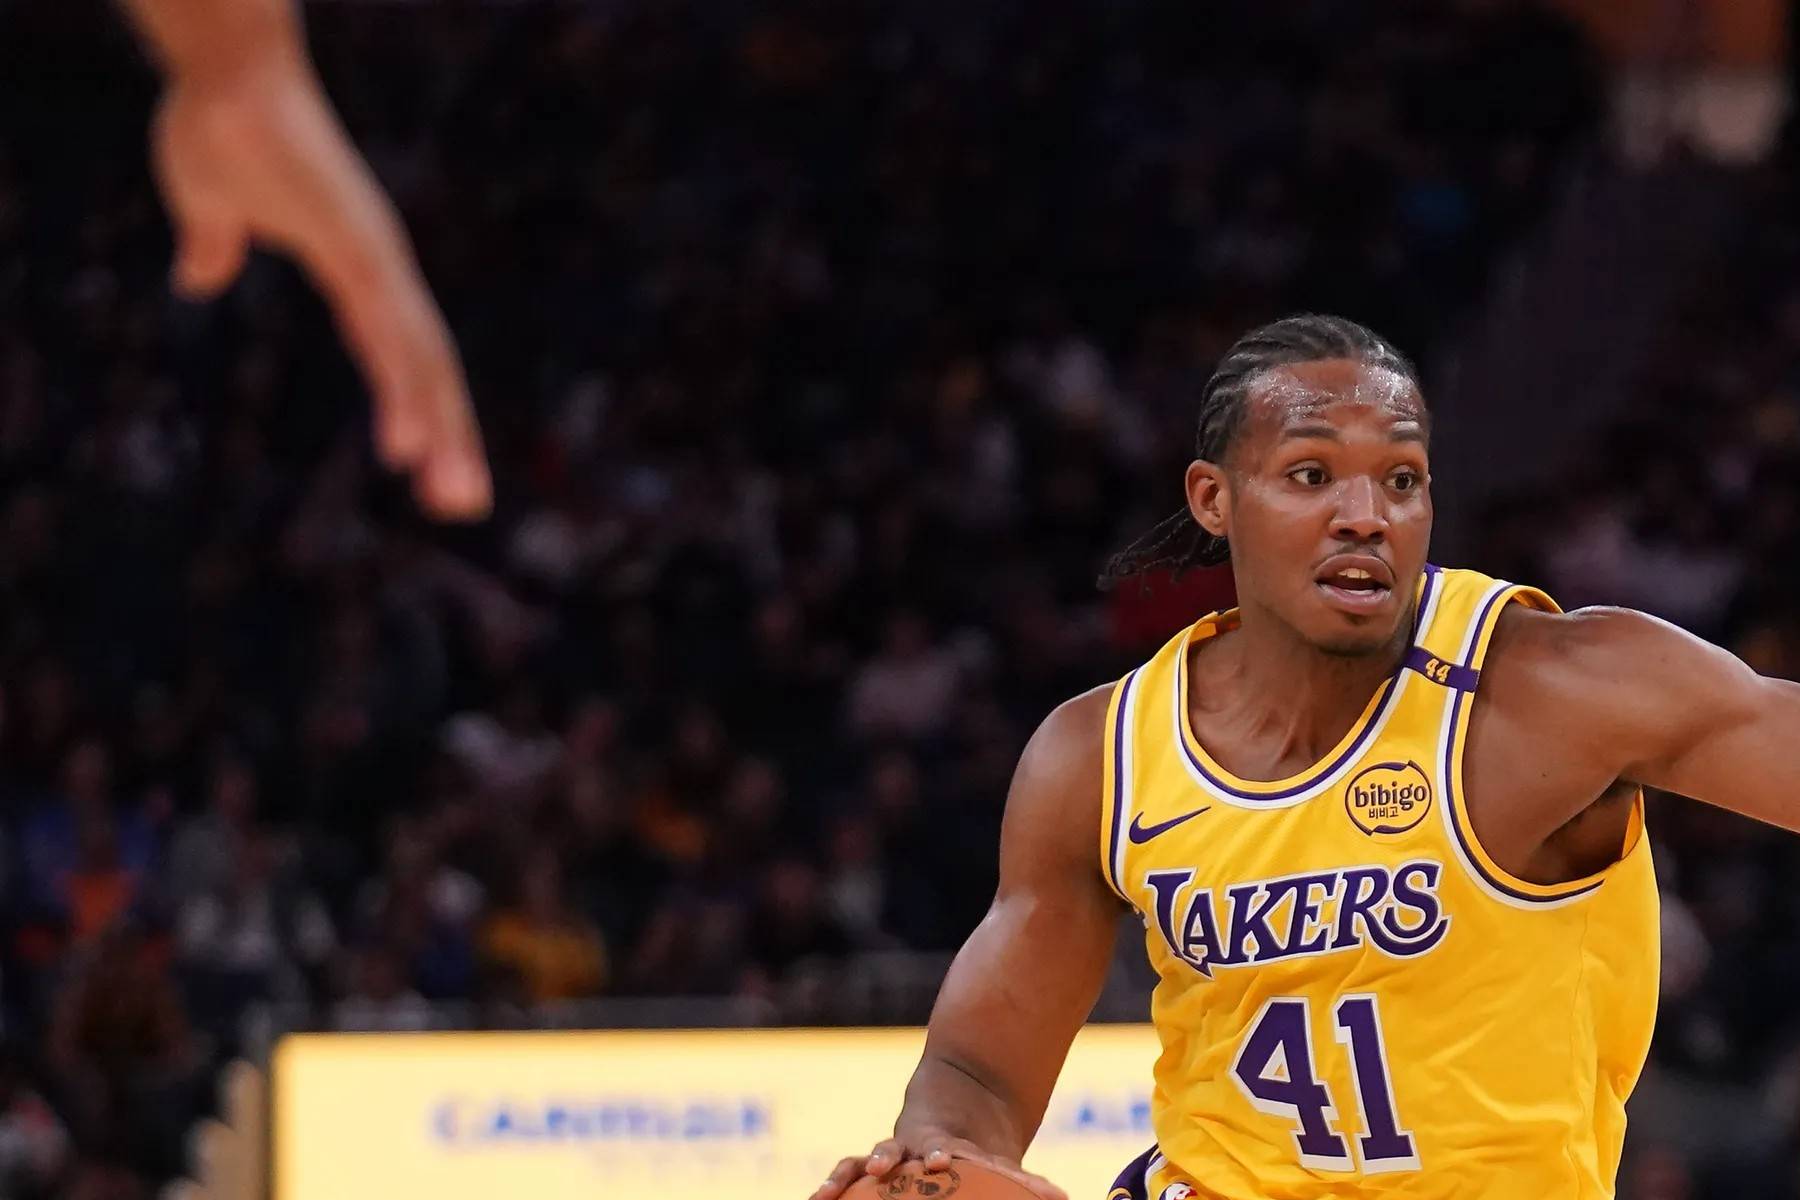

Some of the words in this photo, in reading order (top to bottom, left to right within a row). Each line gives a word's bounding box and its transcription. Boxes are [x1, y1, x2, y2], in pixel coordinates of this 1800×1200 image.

[1425, 658, 1451, 682] 44
[1354, 782, 1427, 811] bibigo
[1144, 860, 1451, 978] LAKERS
[1231, 994, 1422, 1173] 41
